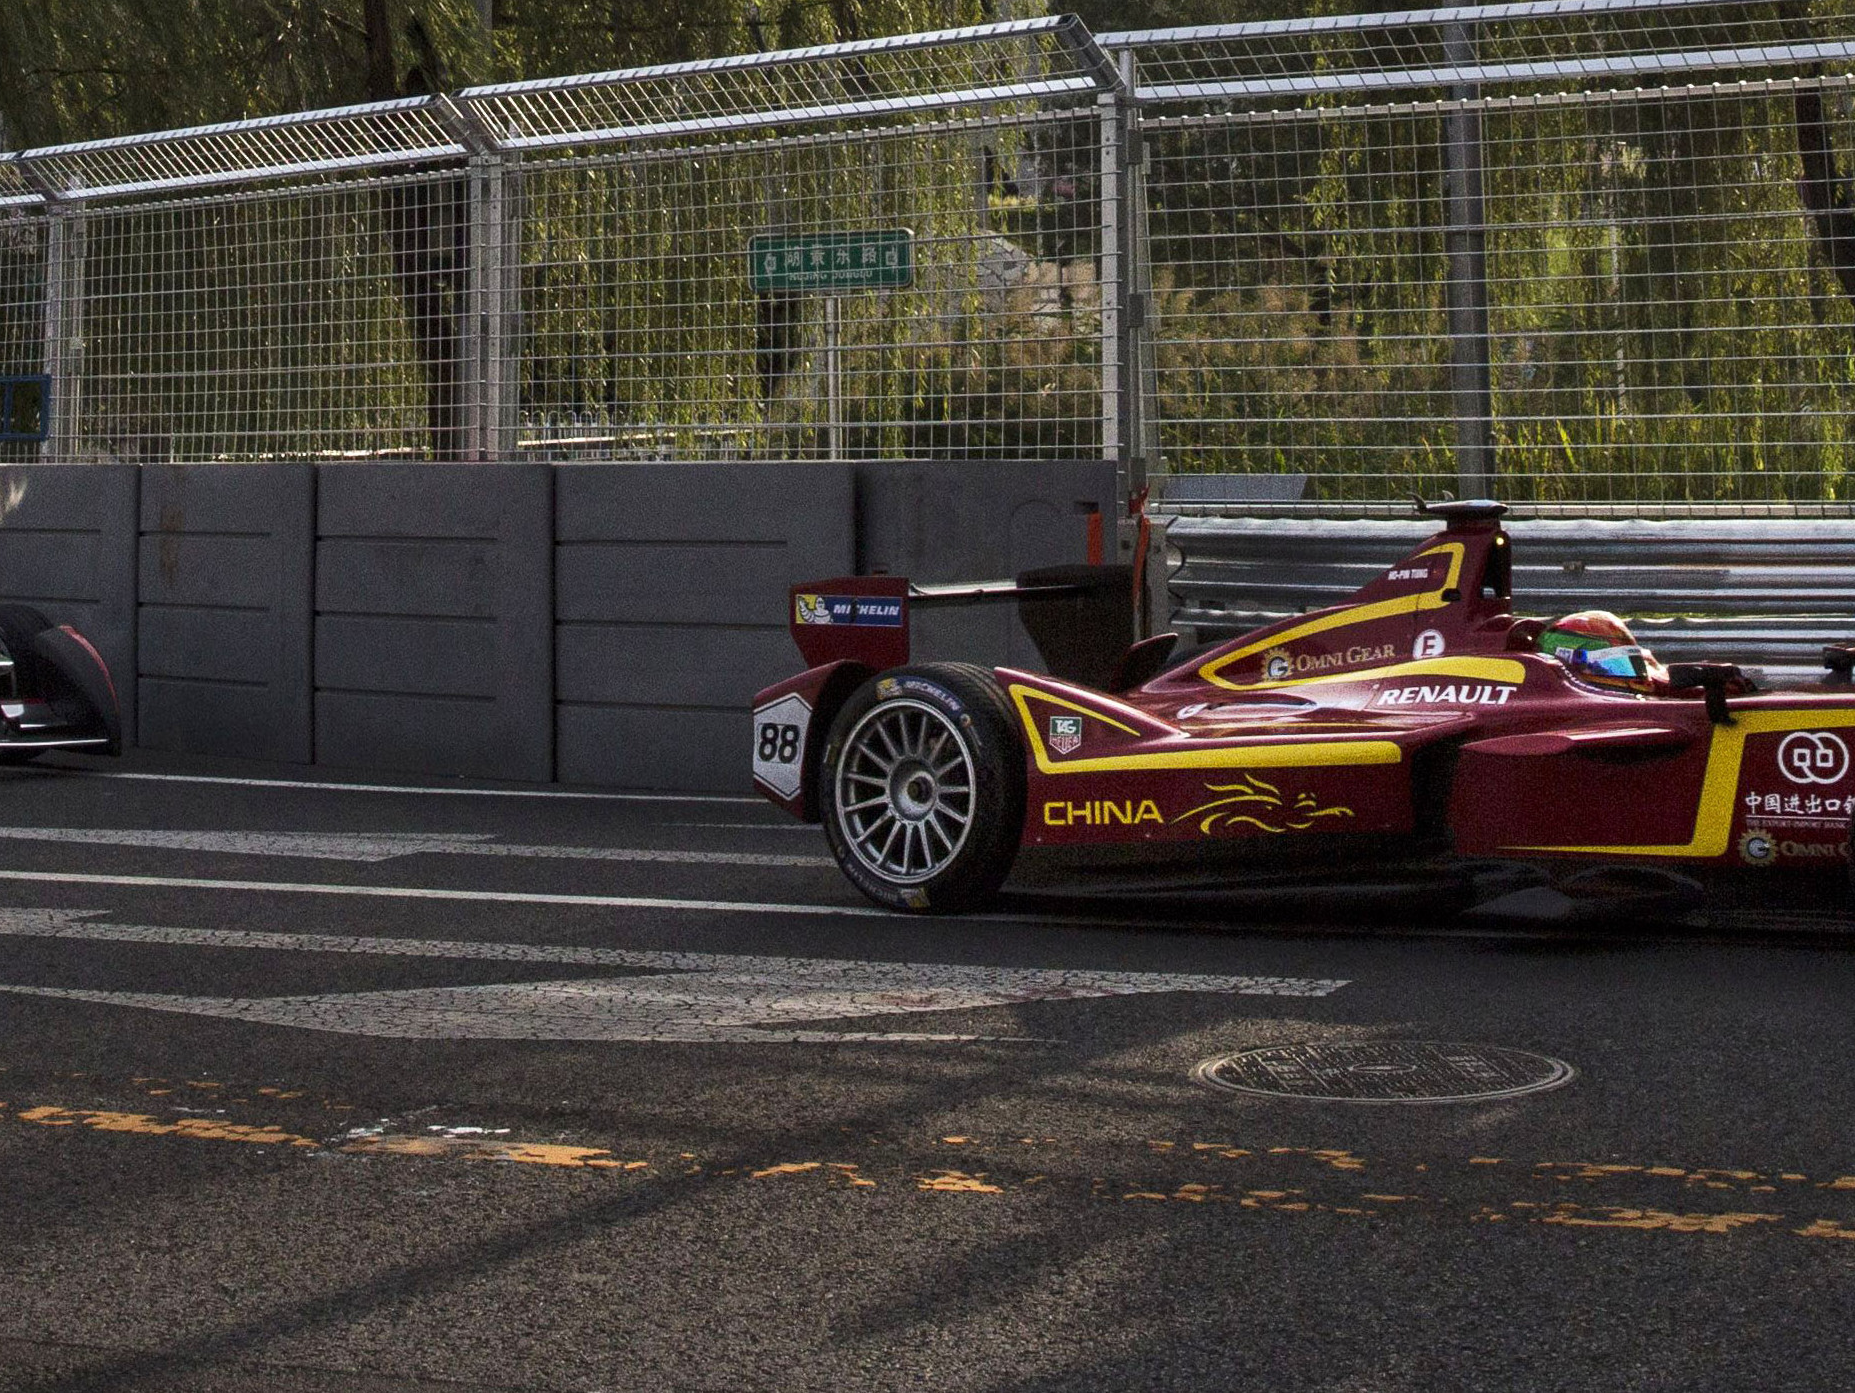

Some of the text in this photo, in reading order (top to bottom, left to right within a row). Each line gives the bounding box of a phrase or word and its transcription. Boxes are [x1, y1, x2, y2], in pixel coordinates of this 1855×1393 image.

[1376, 685, 1518, 707] RENAULT
[1054, 719, 1077, 734] TAG
[758, 722, 800, 764] 88
[1044, 800, 1165, 826] CHINA
